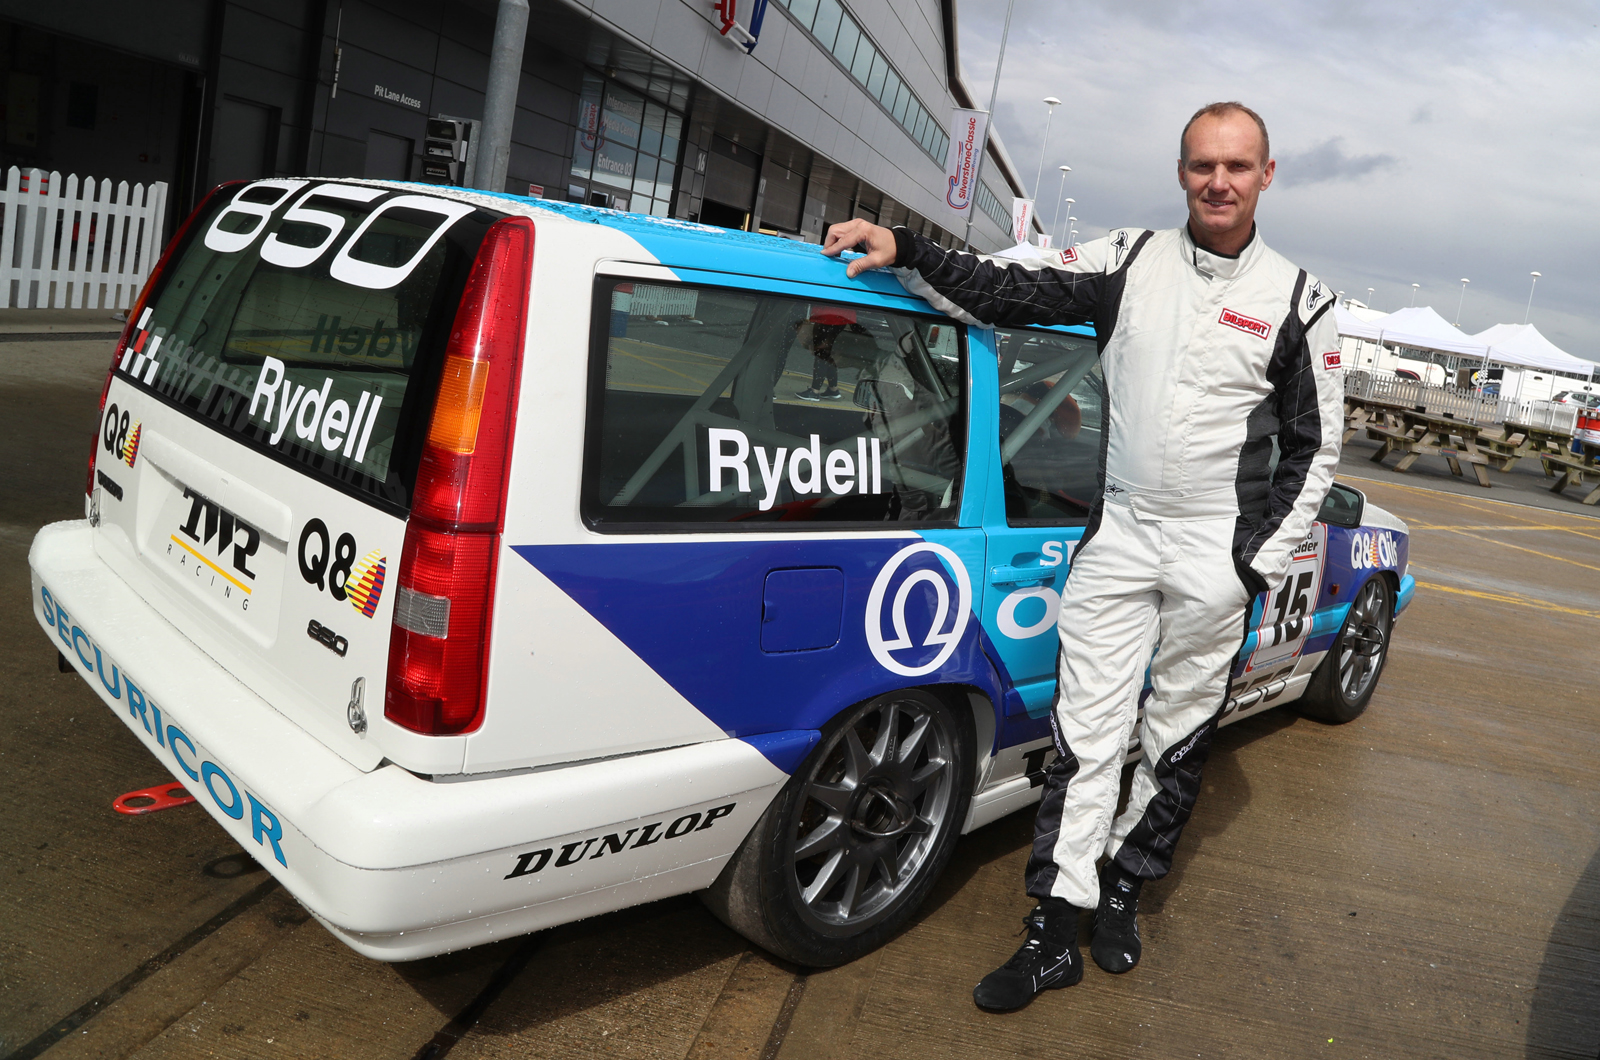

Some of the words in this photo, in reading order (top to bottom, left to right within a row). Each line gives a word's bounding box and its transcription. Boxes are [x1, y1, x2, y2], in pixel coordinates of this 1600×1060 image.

[374, 84, 384, 97] Pit
[384, 88, 400, 102] Lane
[400, 93, 421, 109] Access
[597, 153, 624, 174] Entrance
[624, 162, 633, 177] 03
[697, 152, 706, 172] 16
[959, 117, 977, 200] SilverstoneClassic
[204, 179, 478, 289] 850
[1223, 312, 1267, 335] BILSPORT
[104, 403, 129, 460] Q8
[248, 355, 383, 463] Rydell
[708, 427, 882, 511] Rydell
[179, 487, 260, 581] TWR
[298, 518, 356, 601] Q8
[1351, 533, 1373, 570] Q8
[1378, 531, 1398, 568] Oils
[166, 543, 249, 611] RACING
[1272, 571, 1314, 647] 15
[41, 586, 288, 869] SECURICOR
[504, 803, 736, 880] DUNLOP
